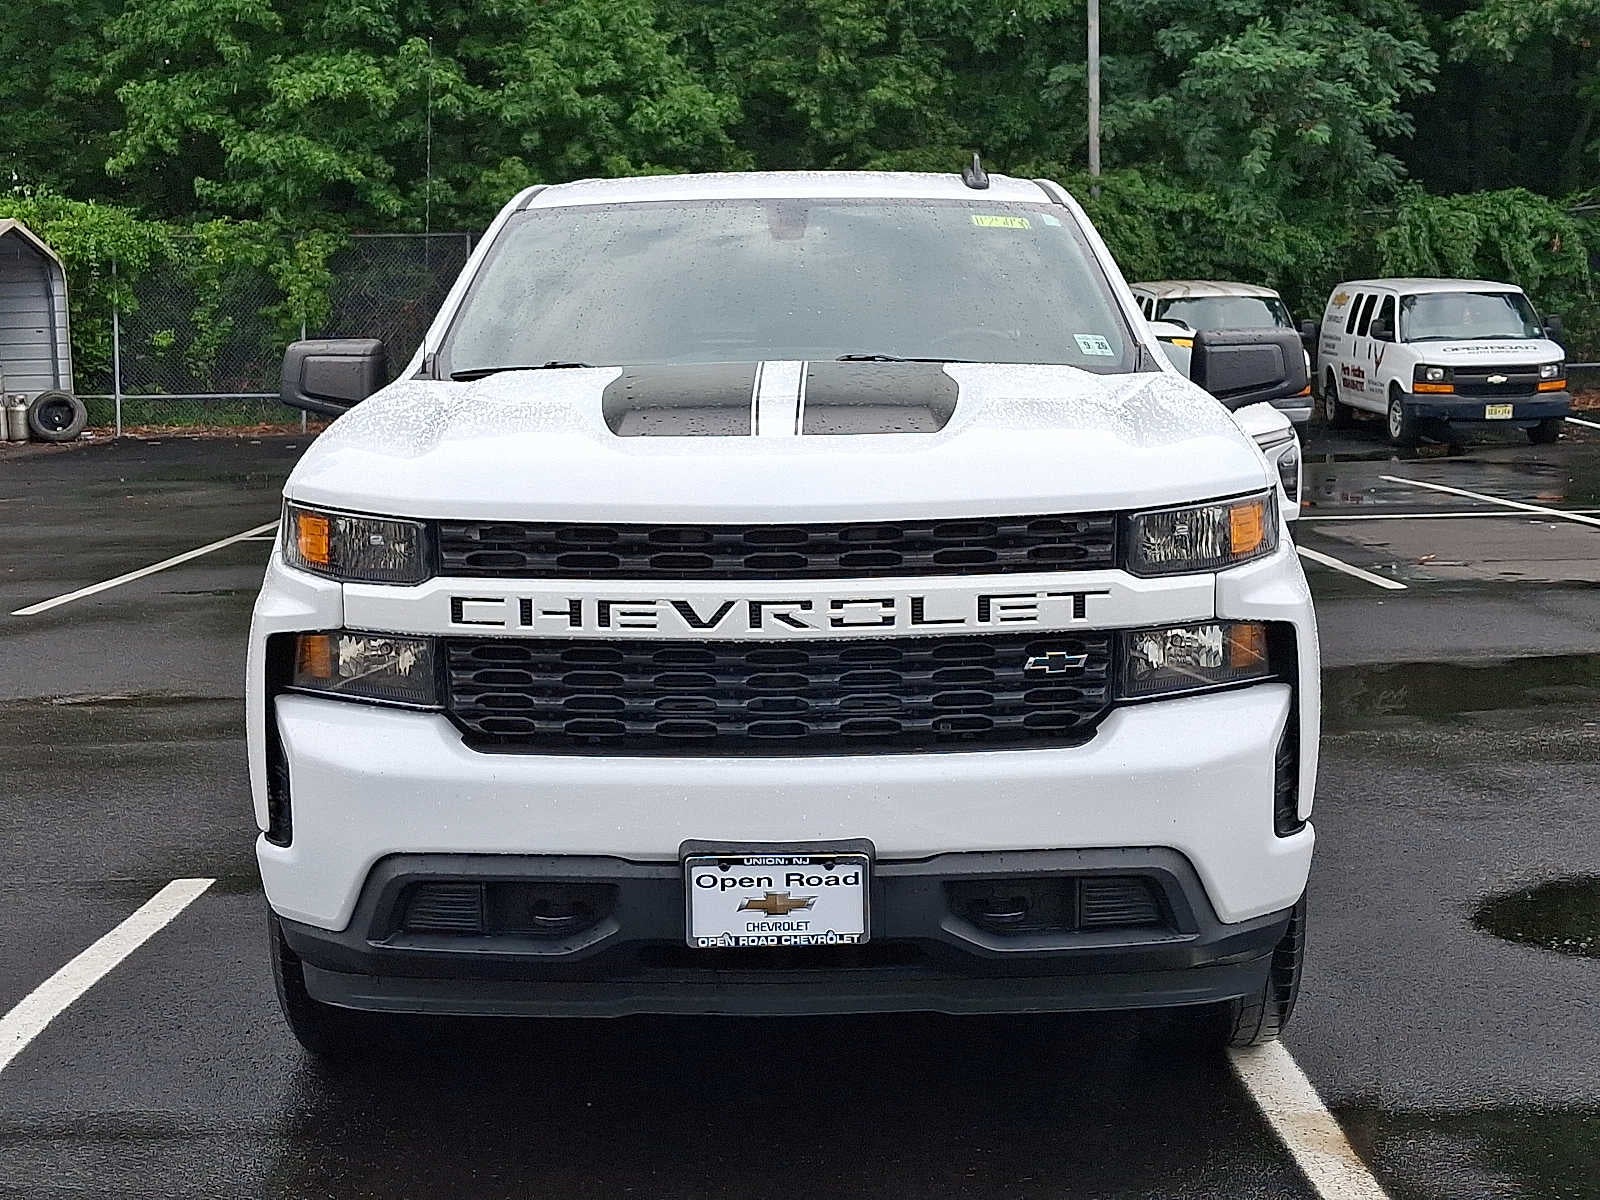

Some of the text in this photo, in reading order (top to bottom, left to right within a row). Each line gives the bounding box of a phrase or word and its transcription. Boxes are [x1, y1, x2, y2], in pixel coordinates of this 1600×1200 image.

[450, 590, 1112, 630] CHEVROLET
[792, 857, 810, 866] NJ
[695, 872, 860, 891] Open Road
[746, 921, 811, 932] CHEVROLET
[698, 934, 860, 947] OPEN ROAD CHEVROLET
